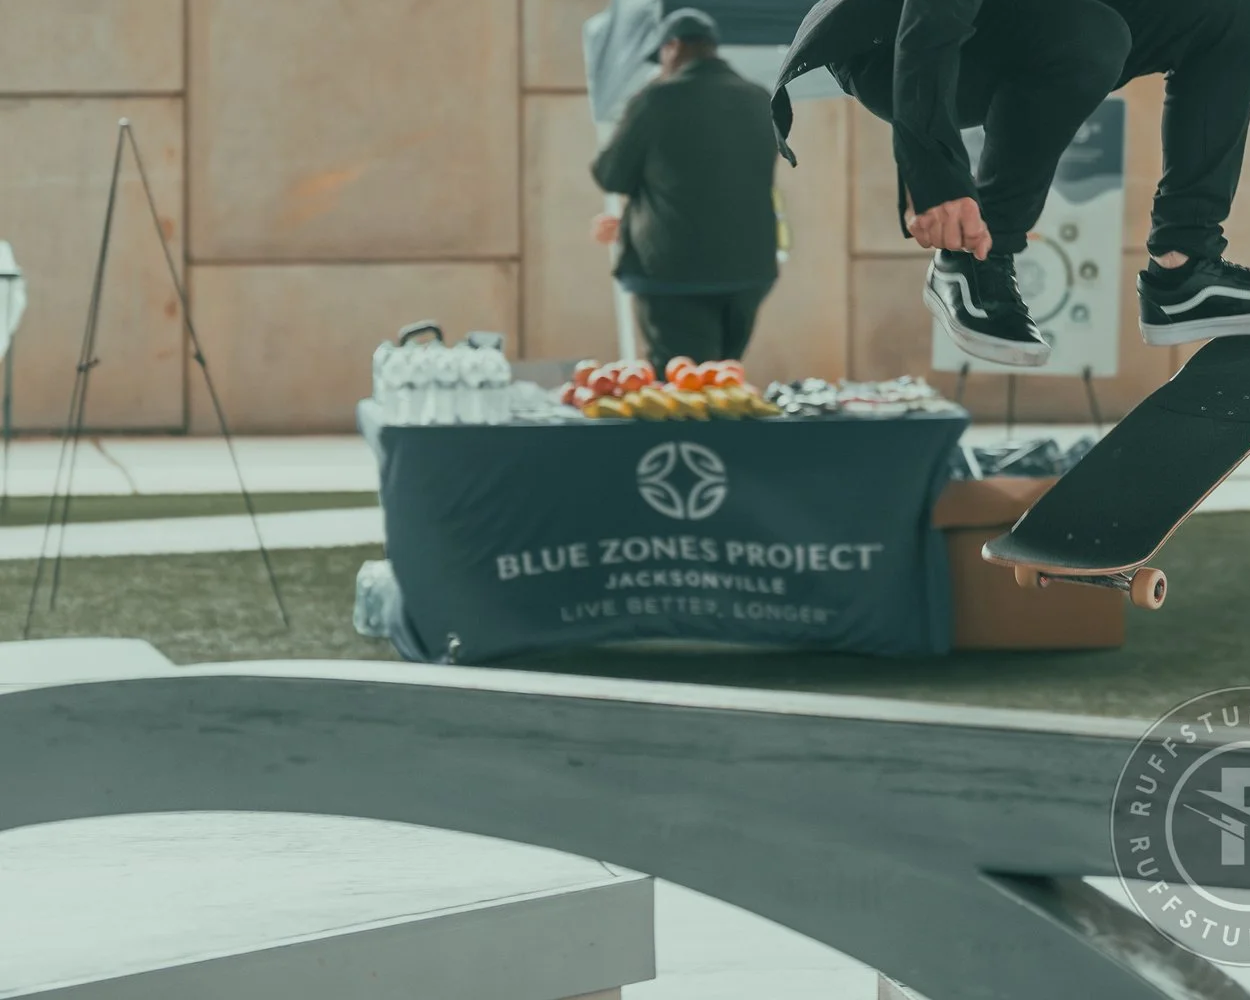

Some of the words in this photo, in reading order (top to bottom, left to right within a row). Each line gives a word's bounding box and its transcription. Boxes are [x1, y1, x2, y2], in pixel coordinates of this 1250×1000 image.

[497, 542, 590, 581] BLUE
[598, 536, 719, 565] ZONES
[726, 541, 880, 573] PROJECT
[605, 570, 786, 595] JACKSONVILLE
[560, 601, 618, 622] LIVE
[733, 602, 830, 624] LONGER
